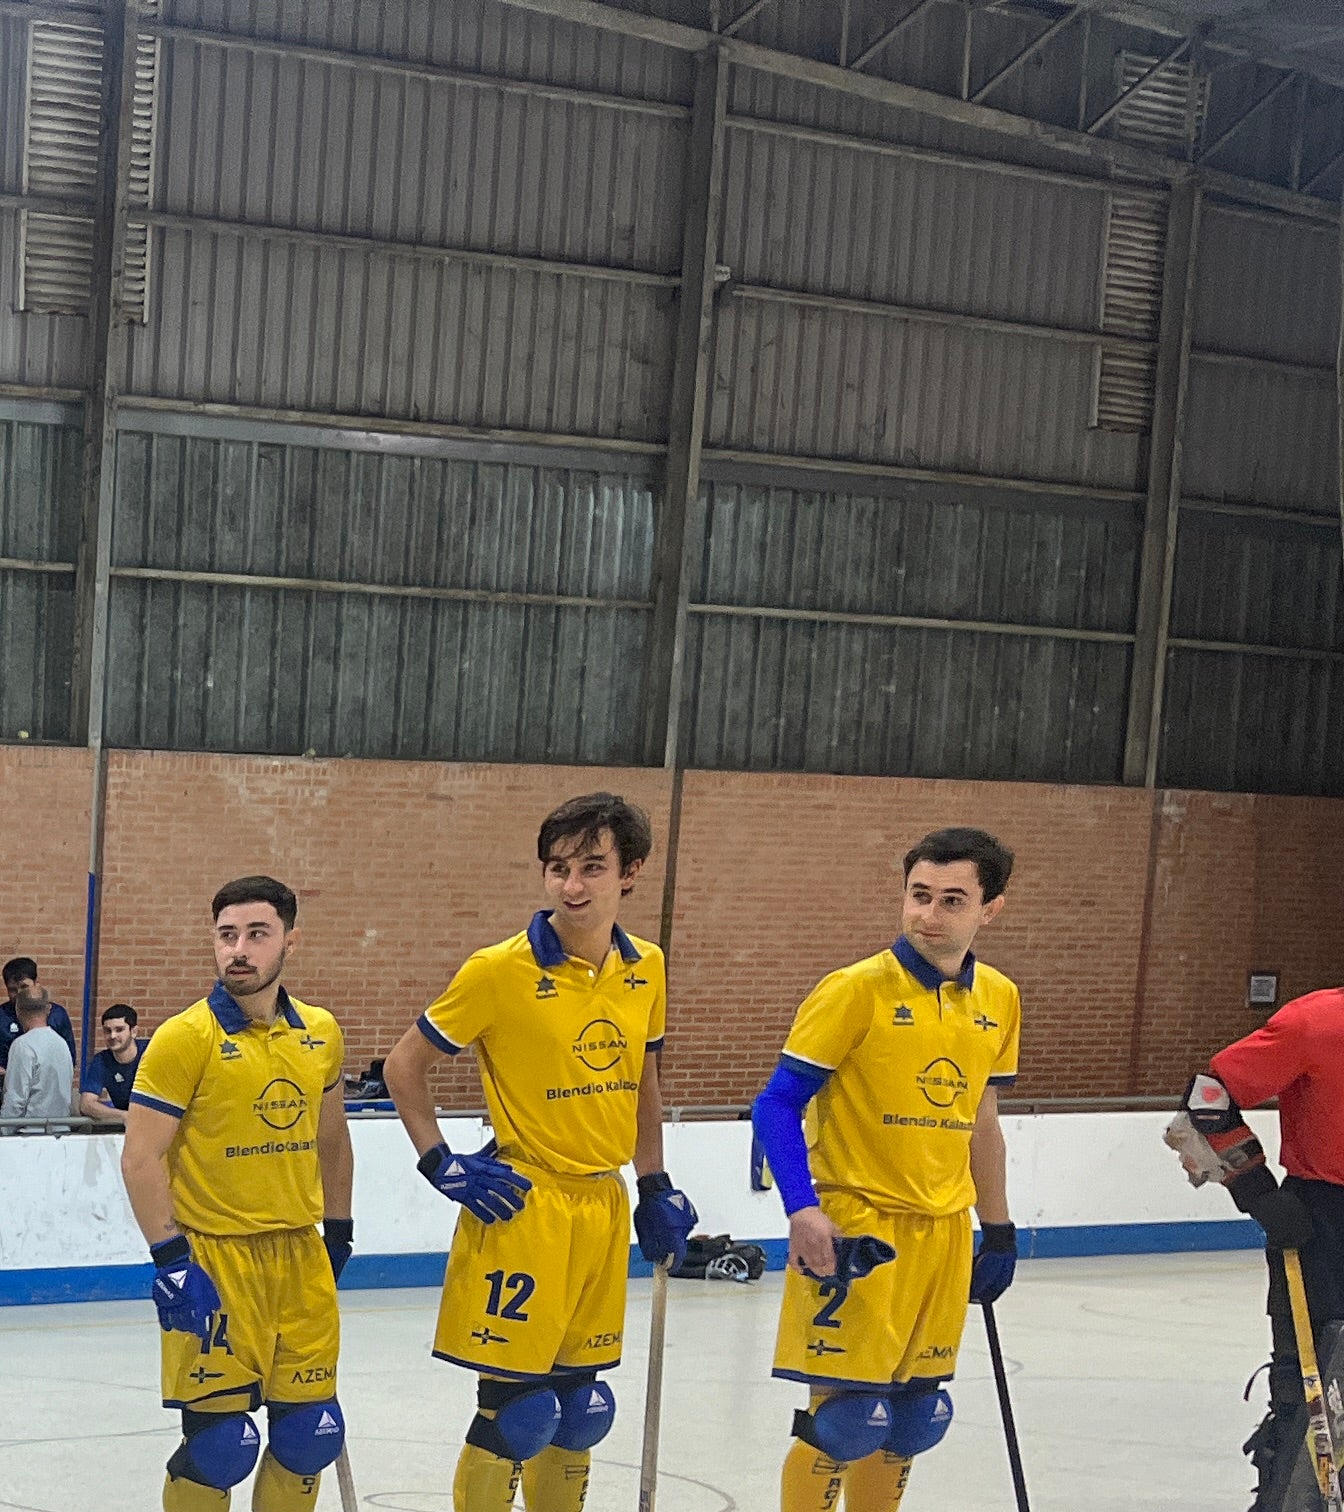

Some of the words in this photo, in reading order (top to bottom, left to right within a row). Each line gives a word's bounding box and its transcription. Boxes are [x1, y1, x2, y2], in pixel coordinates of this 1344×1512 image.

[572, 1040, 627, 1053] NISSAN
[546, 1082, 603, 1100] Blendio
[883, 1114, 937, 1128] Blendio
[225, 1142, 284, 1158] Blendio
[485, 1270, 536, 1321] 12
[813, 1280, 848, 1328] 2
